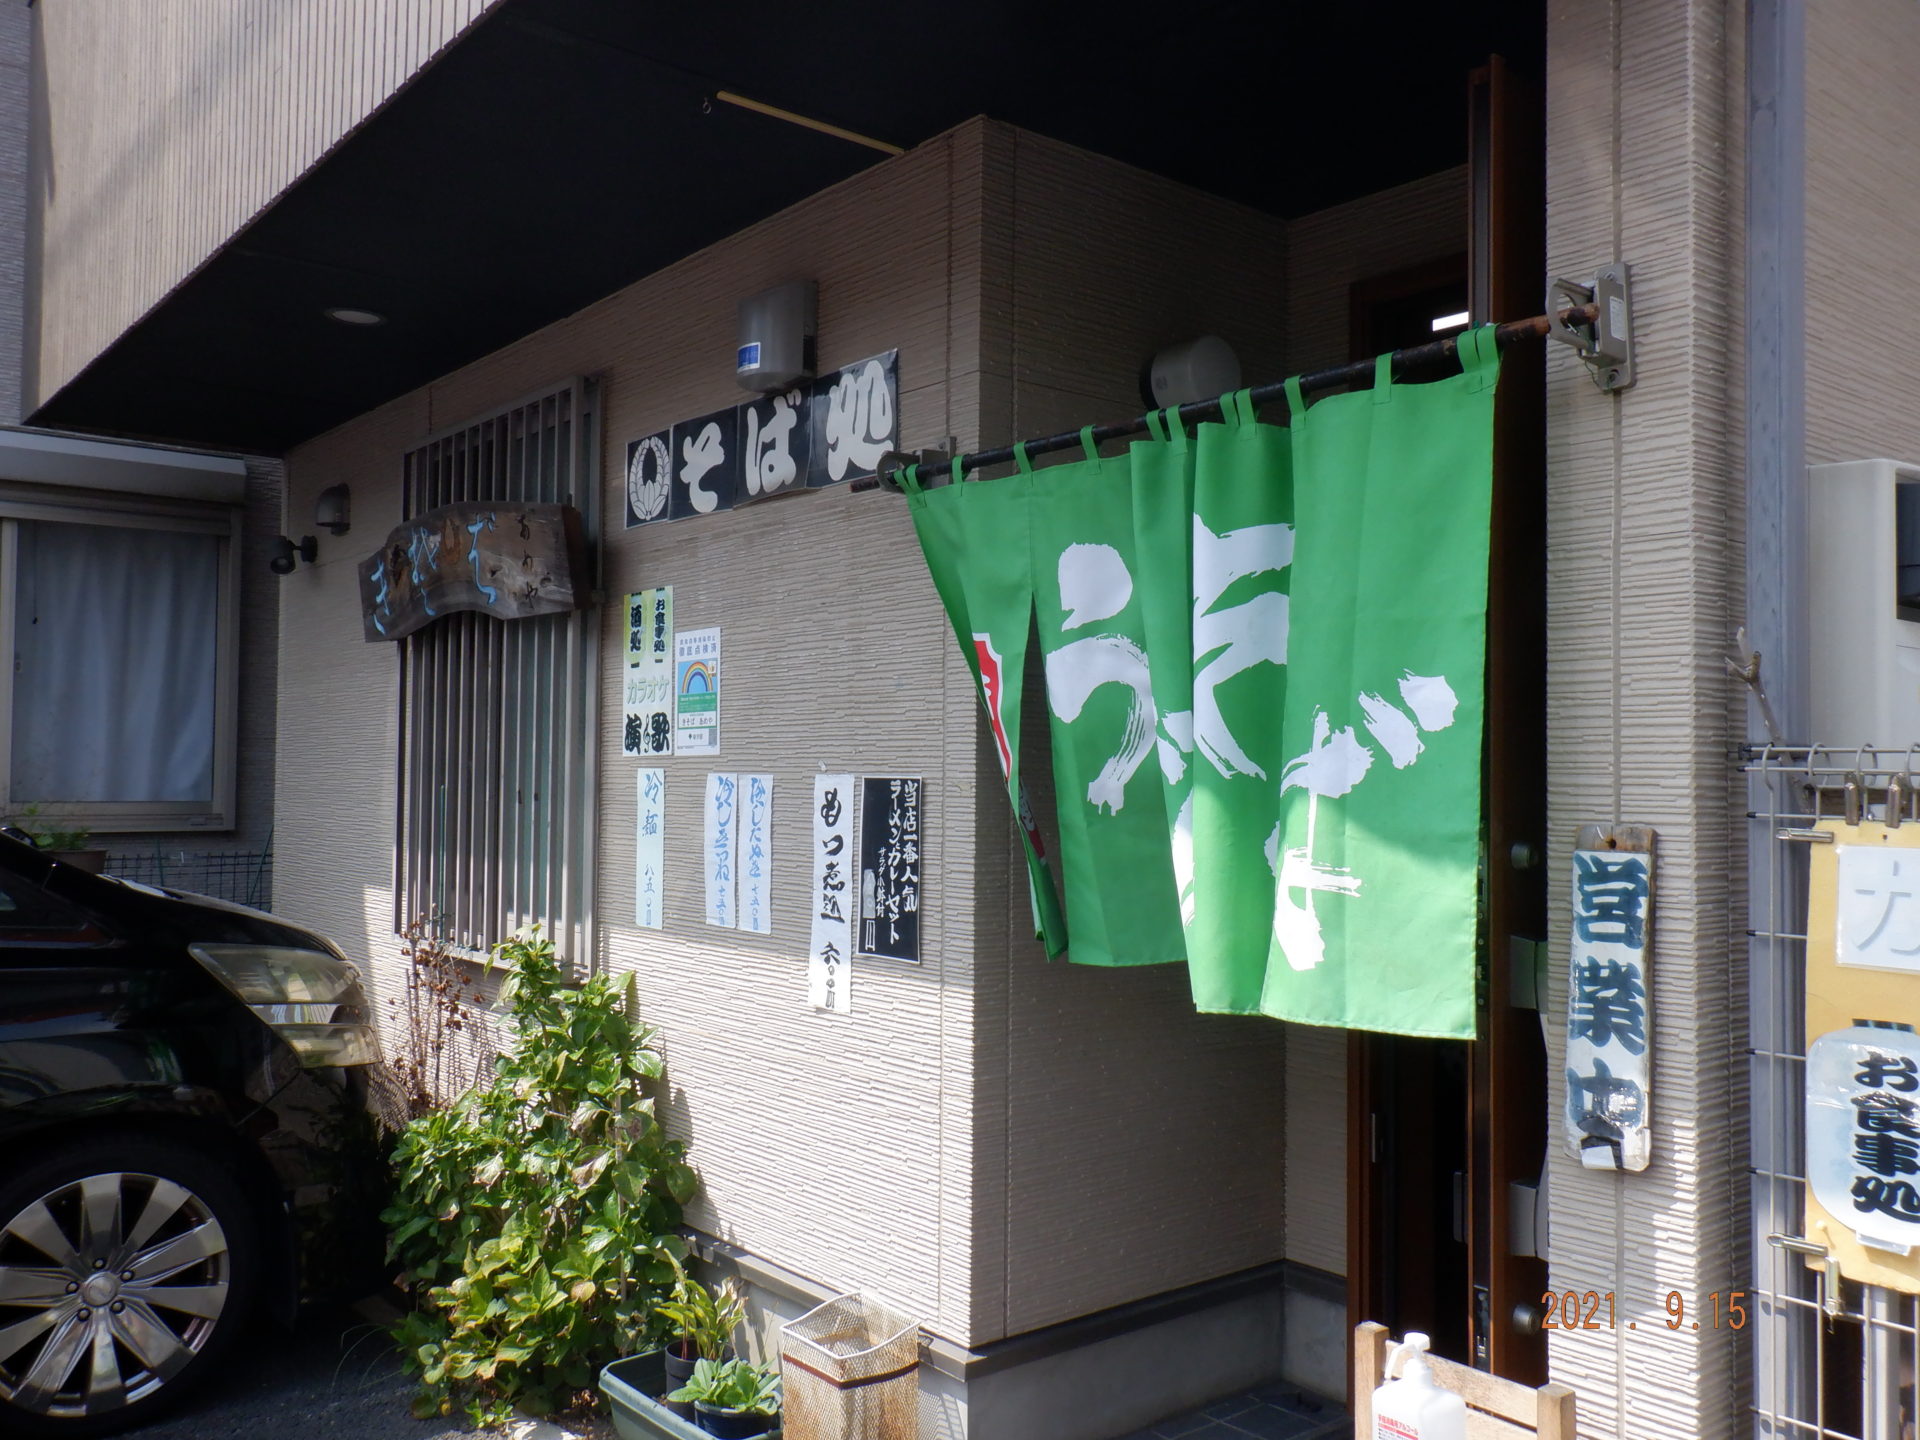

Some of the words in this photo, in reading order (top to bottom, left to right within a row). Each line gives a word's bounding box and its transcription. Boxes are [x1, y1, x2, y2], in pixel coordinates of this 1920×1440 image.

[679, 358, 894, 513] そば処
[630, 604, 642, 653] 酒処
[654, 598, 666, 653] お食事処
[625, 711, 670, 755] 演歌
[627, 674, 669, 704] カラオケ
[900, 780, 919, 912] 当店一番人気
[1566, 852, 1649, 1142] 営業中
[1850, 1050, 1920, 1224] お食事処
